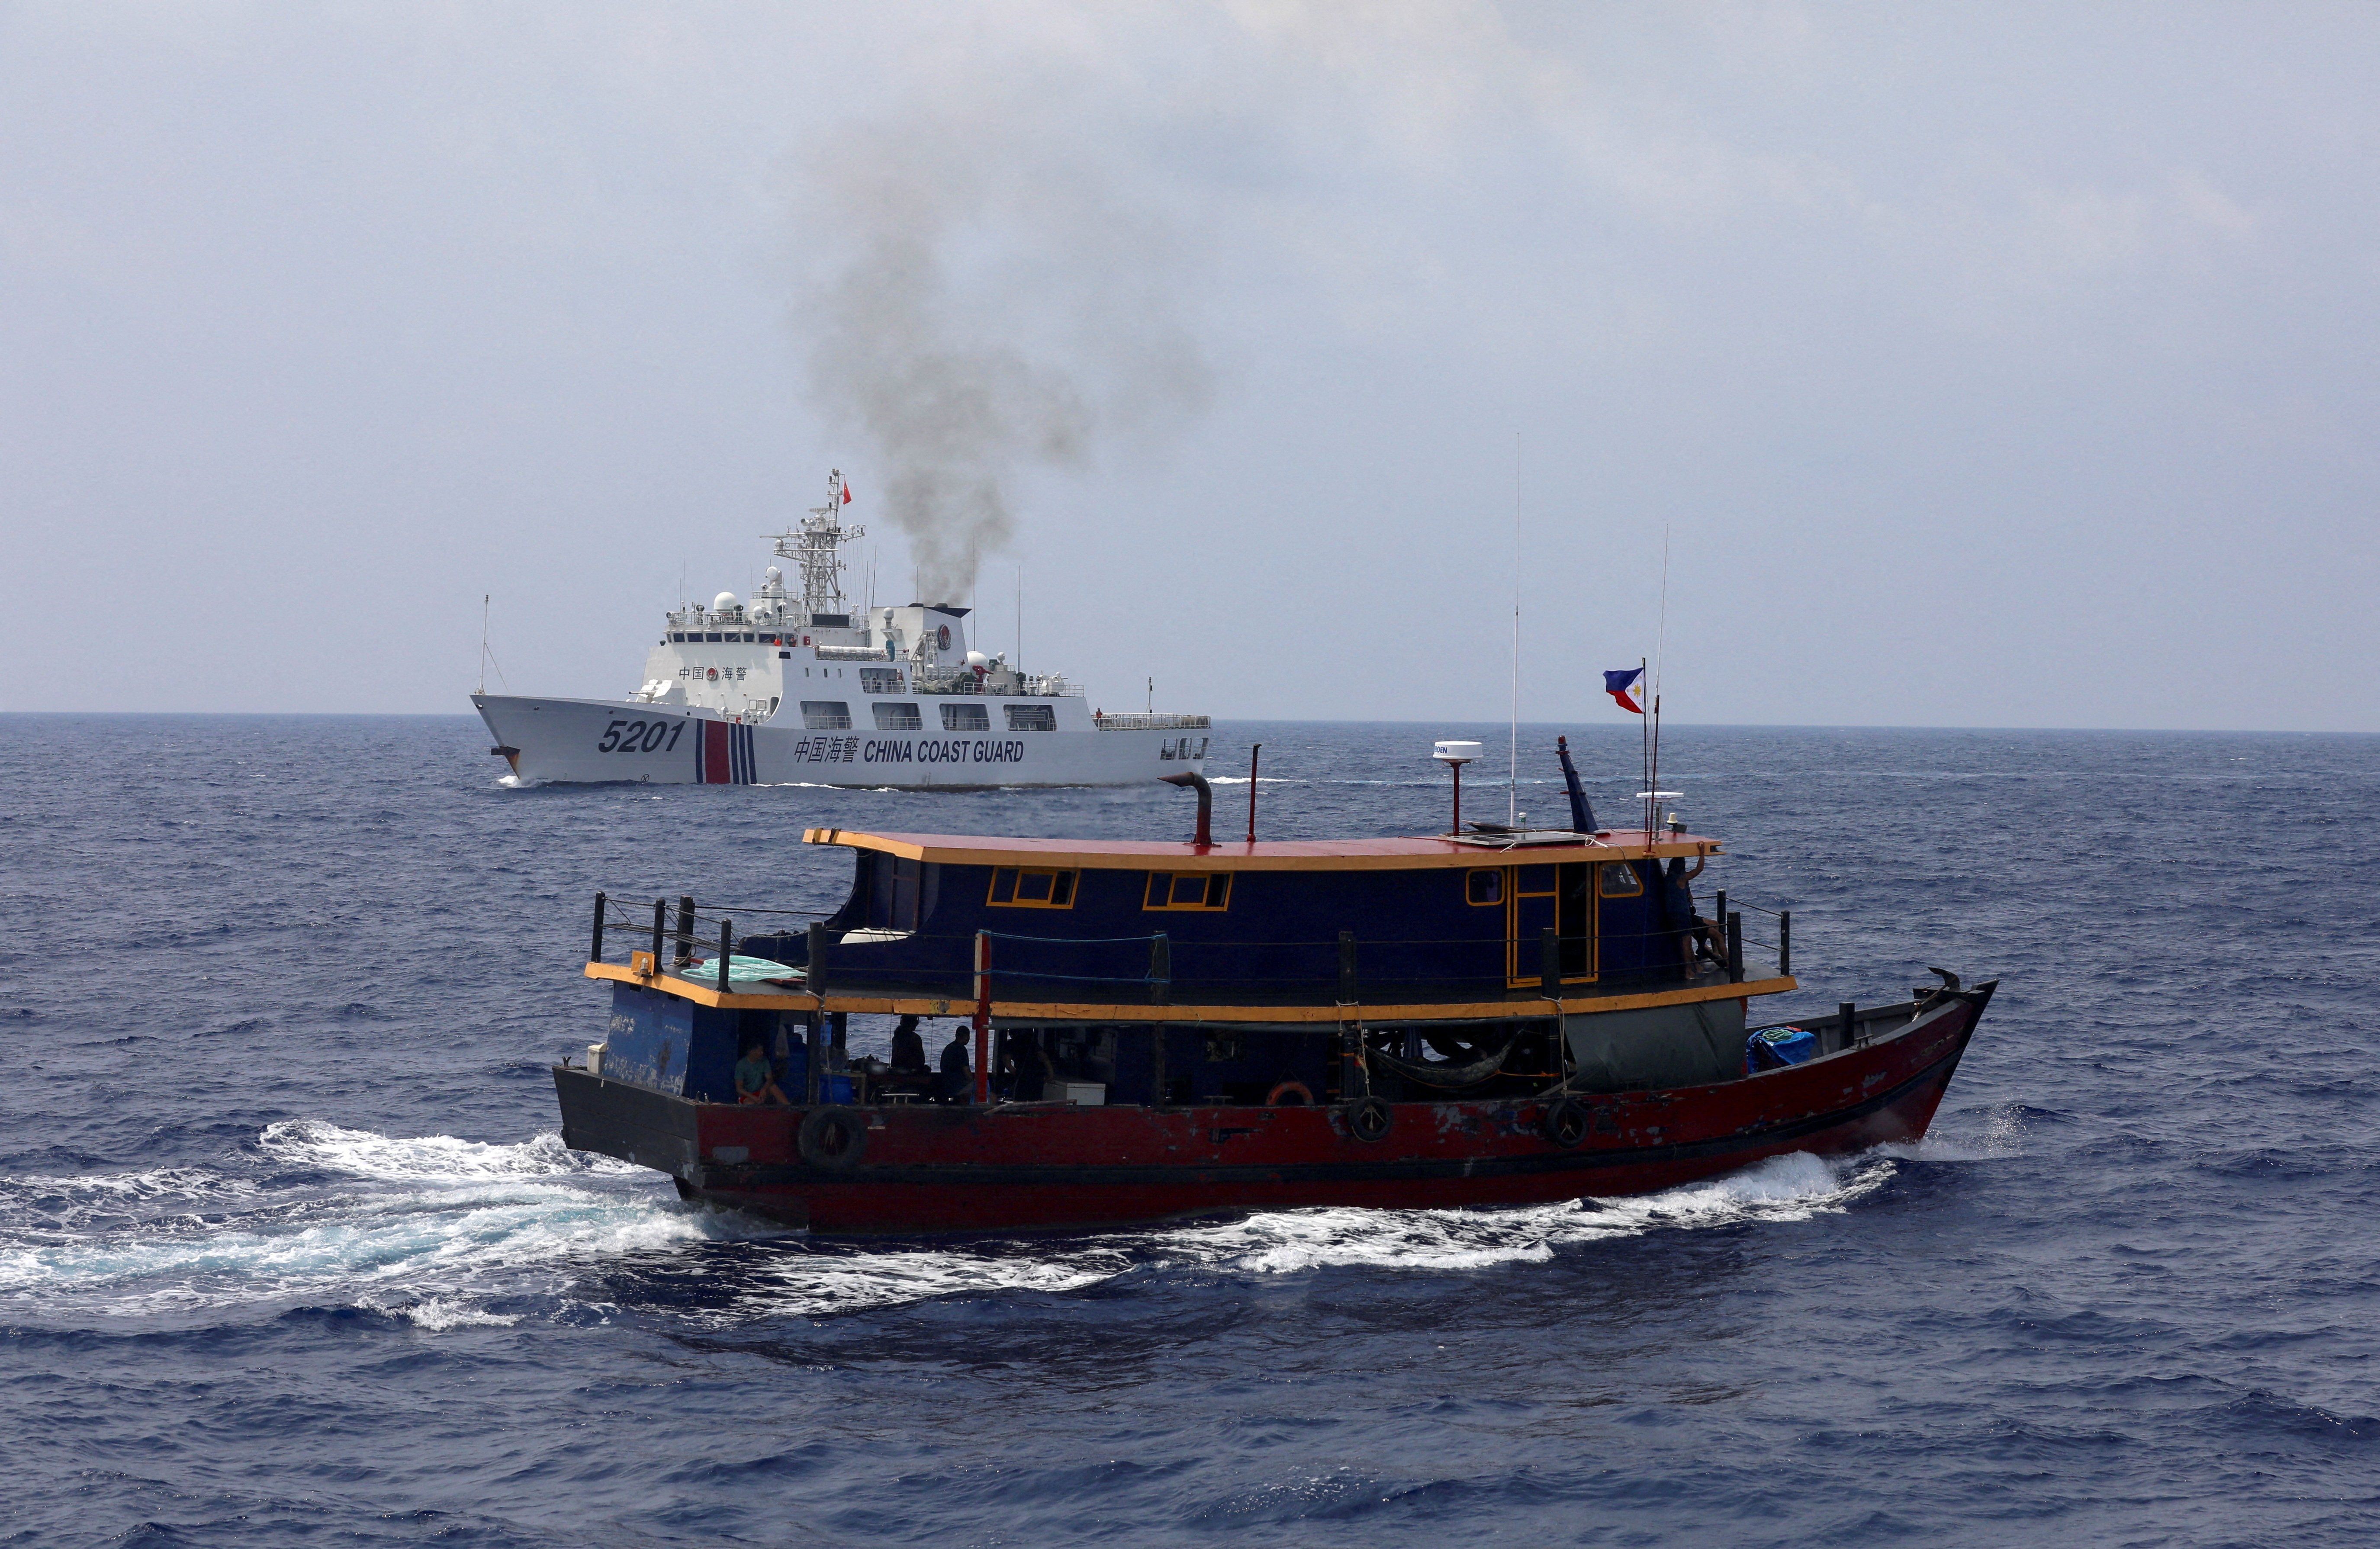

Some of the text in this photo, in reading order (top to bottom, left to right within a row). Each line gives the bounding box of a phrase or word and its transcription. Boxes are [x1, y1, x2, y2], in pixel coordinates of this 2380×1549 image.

[679, 666, 747, 681] 中国 海警
[598, 720, 686, 752] 5201
[794, 736, 860, 763] 中国海警
[864, 740, 1024, 762] CHINA COAST GUARD
